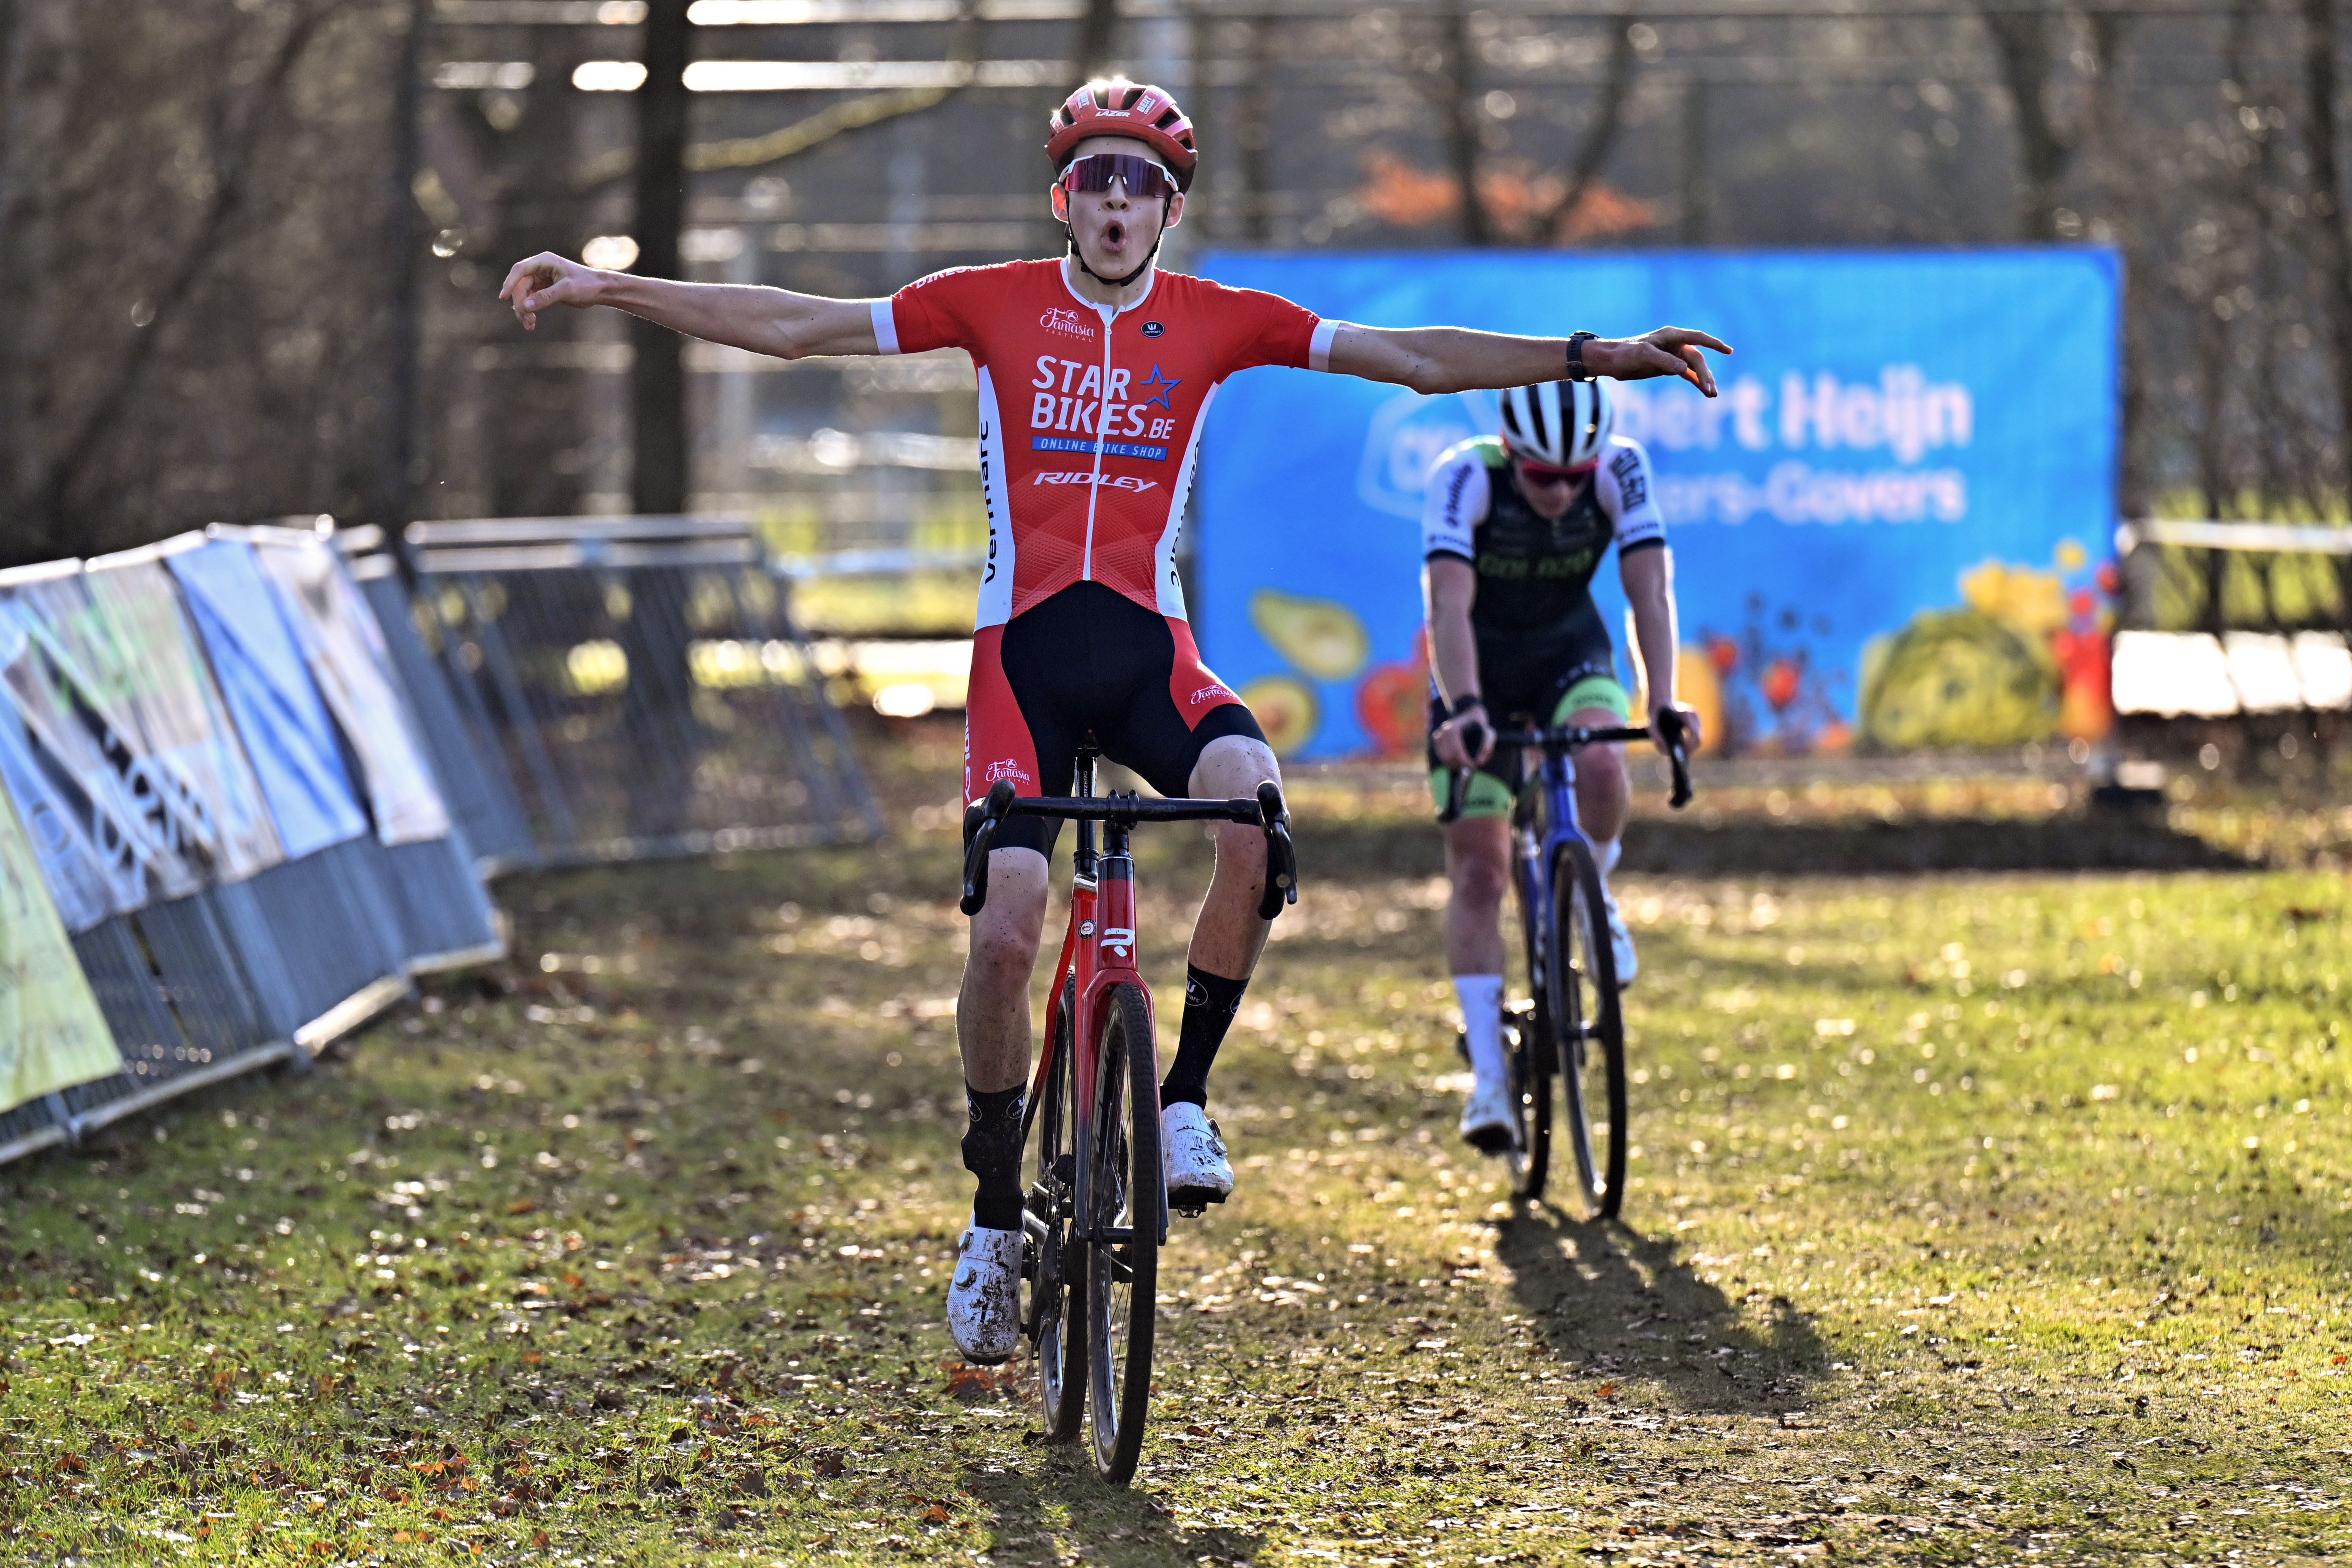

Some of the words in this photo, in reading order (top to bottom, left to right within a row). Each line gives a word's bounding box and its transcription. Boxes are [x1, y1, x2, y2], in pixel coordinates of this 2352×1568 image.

[1040, 308, 1094, 338] Fantasia
[1046, 329, 1092, 342] FESTIVAL
[1032, 355, 1131, 400] STAR
[1031, 392, 1175, 439] BIKES.BE
[1612, 374, 1768, 449] bert
[1781, 364, 1973, 463] Heijn
[1041, 438, 1086, 451] ONLINE
[1093, 442, 1127, 454] BIKE
[1132, 446, 1162, 458] SHOP
[1034, 472, 1158, 492] RIDLEY
[986, 761, 1030, 781] Fantasia
[1186, 993, 1200, 1003] marc
